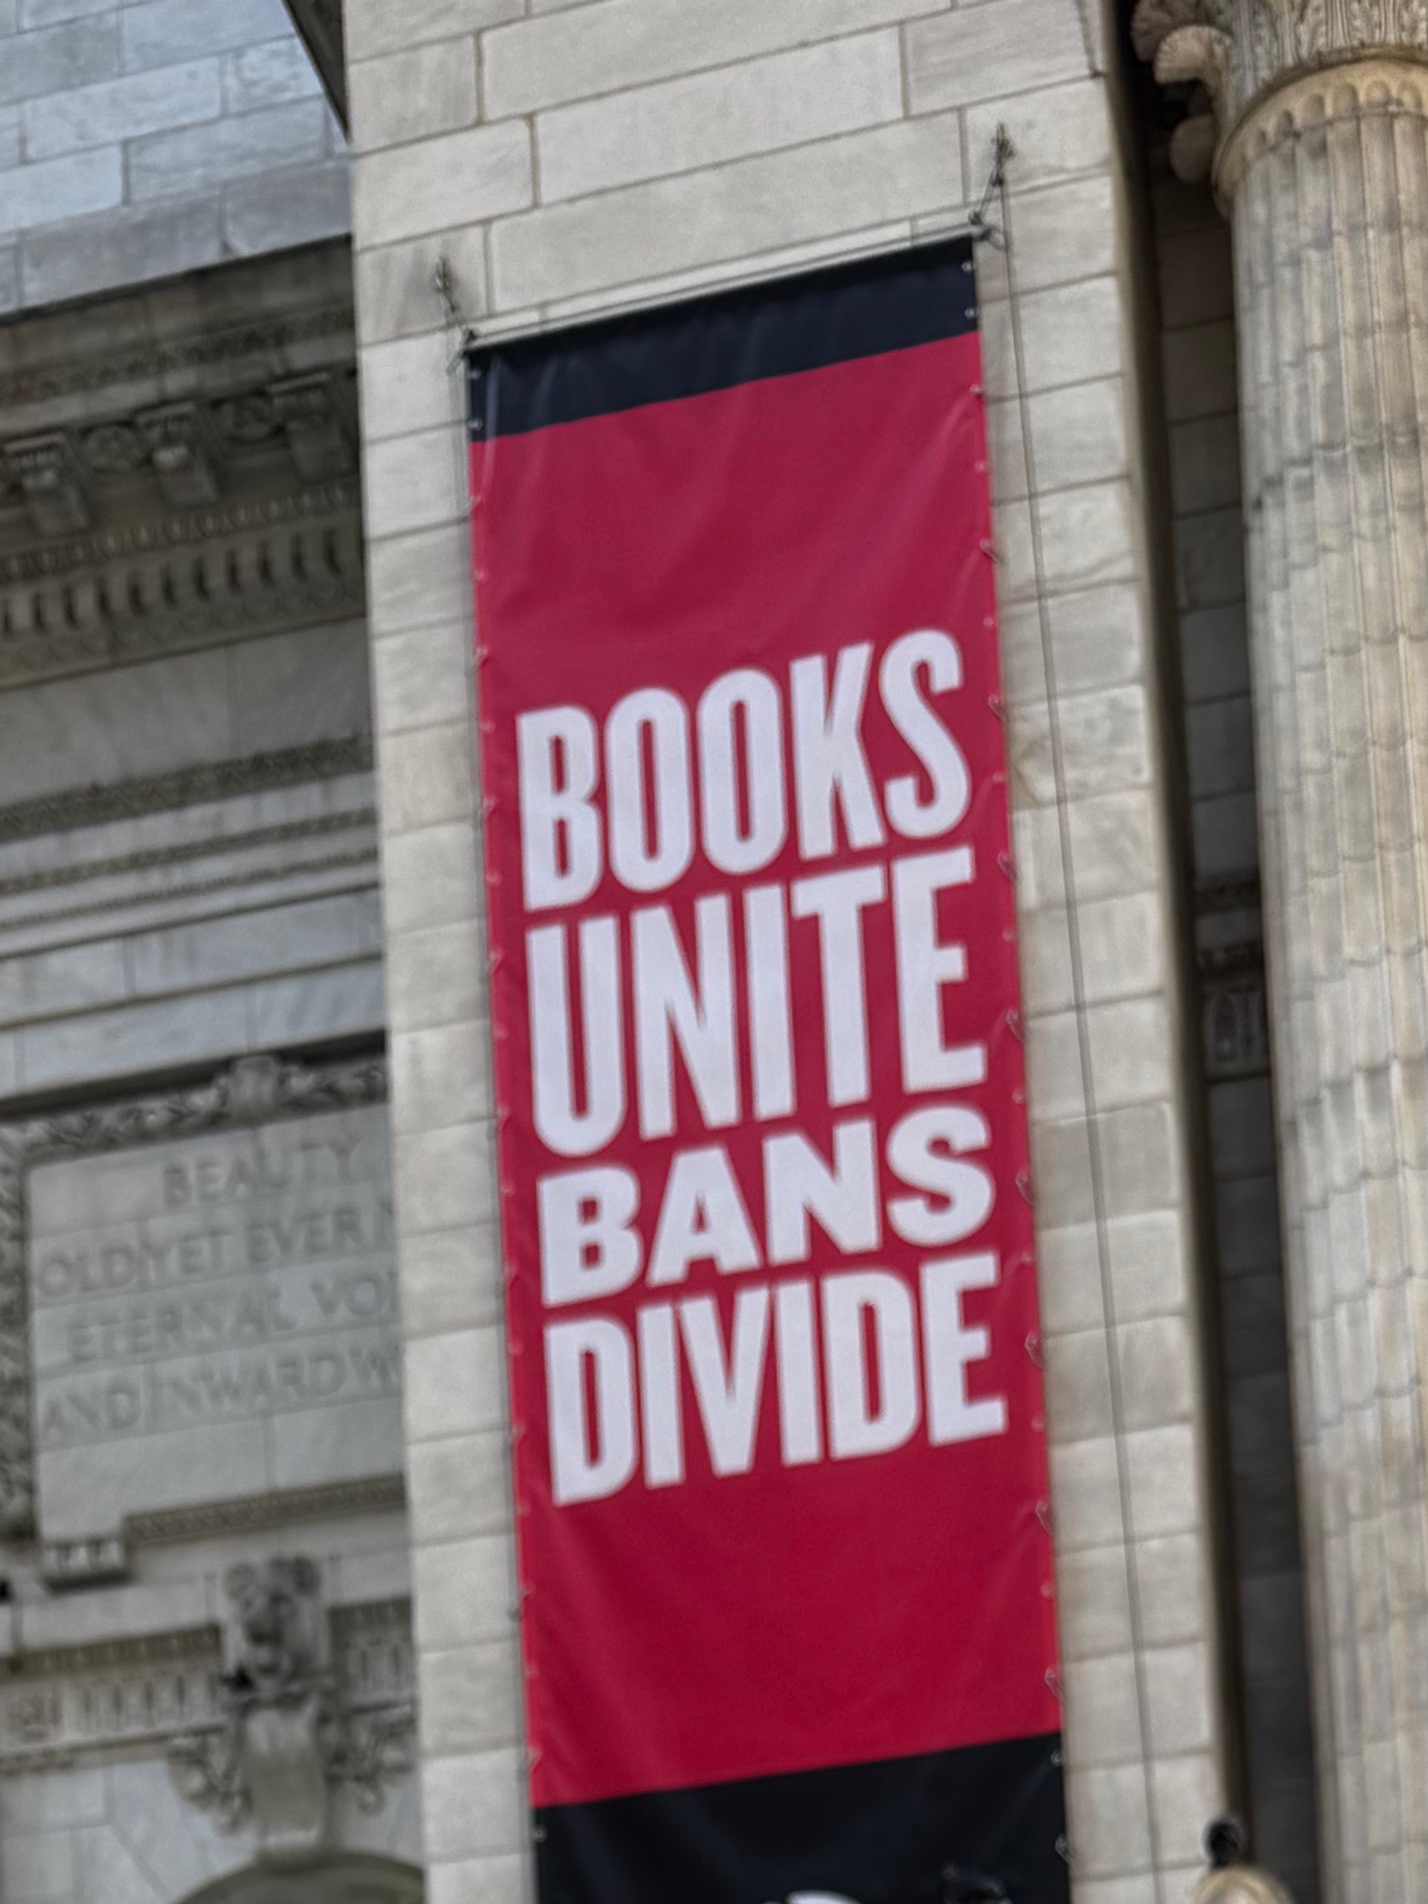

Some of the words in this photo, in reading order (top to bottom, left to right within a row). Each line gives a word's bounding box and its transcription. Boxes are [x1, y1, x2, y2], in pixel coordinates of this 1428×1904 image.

[516, 628, 970, 912] BOOKS
[525, 844, 987, 1156] UNITE
[162, 1134, 362, 1209] BEAUTY
[536, 1104, 994, 1307] BANS
[36, 1243, 137, 1298] OLD
[139, 1225, 232, 1289] YET
[246, 1204, 364, 1263] EVER
[68, 1287, 298, 1363] ETERNAL
[43, 1376, 142, 1440] AND
[543, 1251, 1007, 1505] DIVIDE
